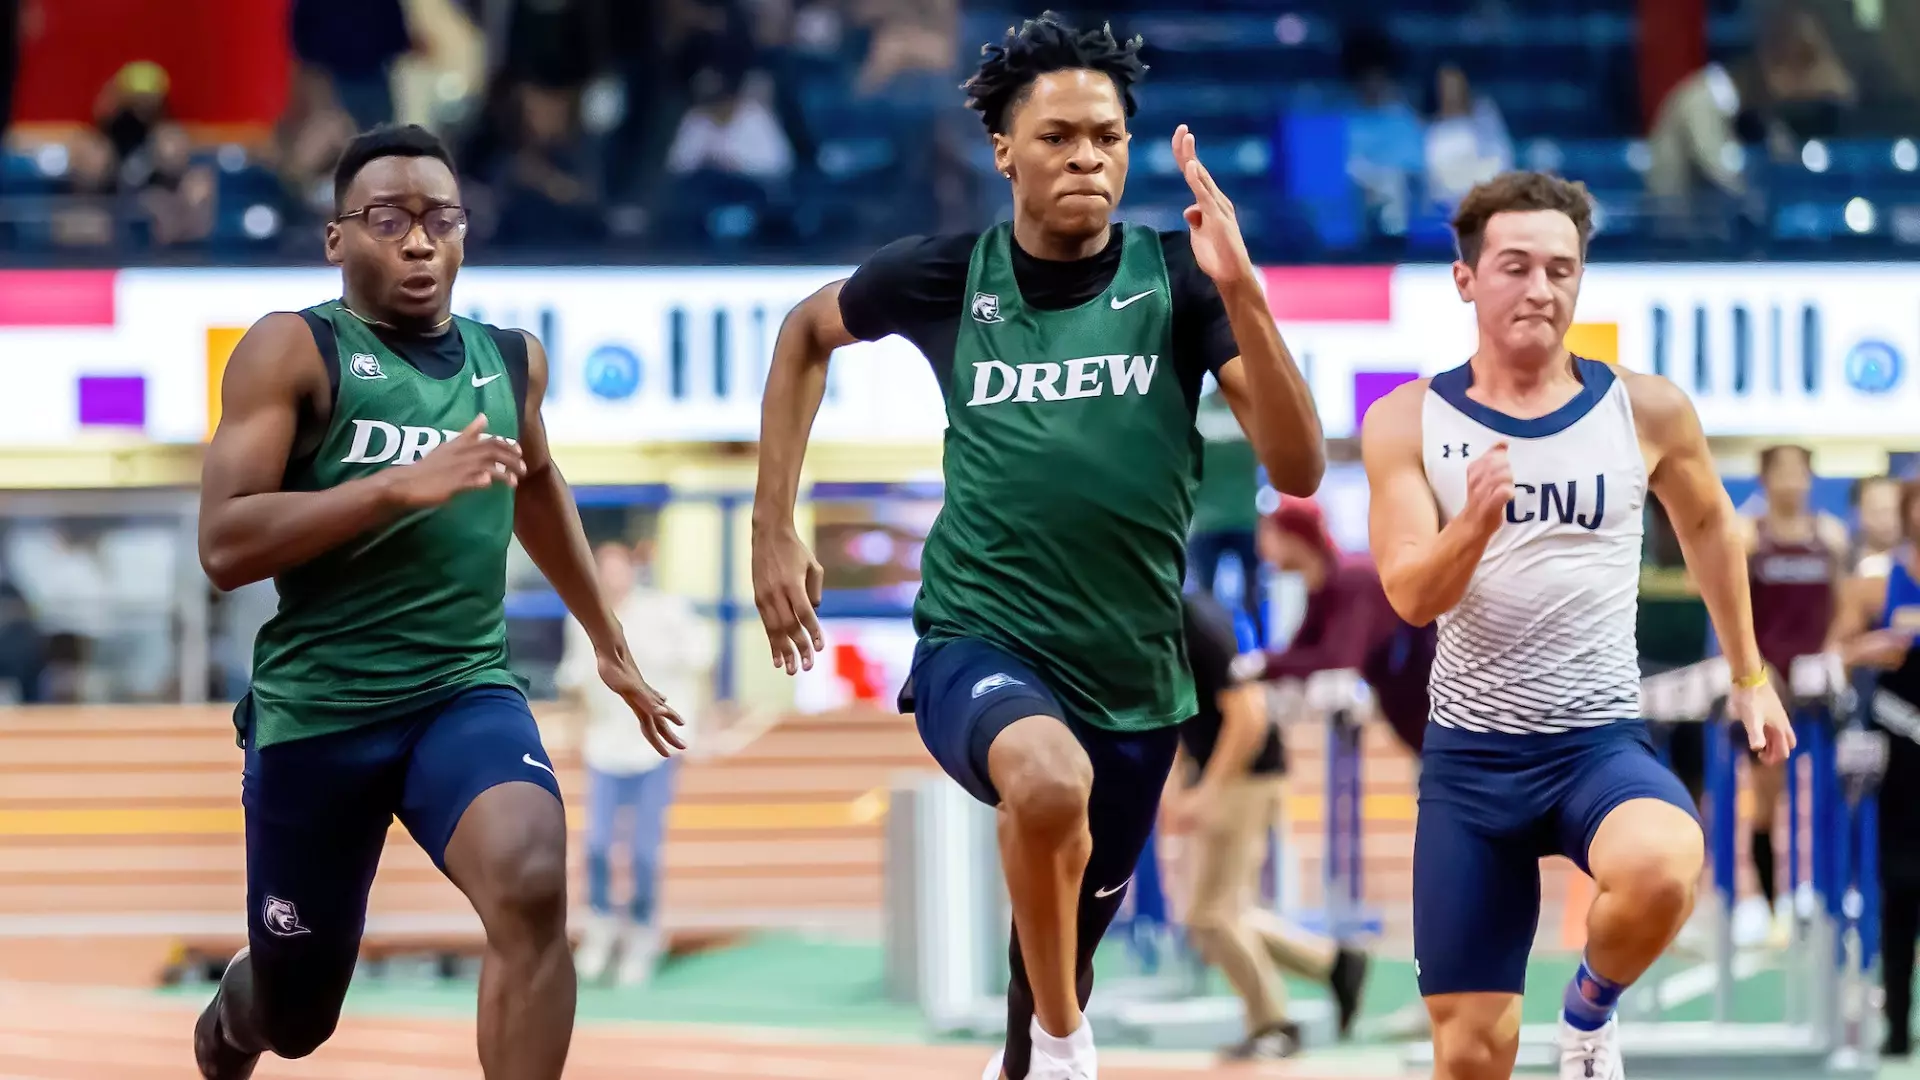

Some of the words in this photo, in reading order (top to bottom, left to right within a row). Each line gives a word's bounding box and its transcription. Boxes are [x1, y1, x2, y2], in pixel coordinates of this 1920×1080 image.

[966, 354, 1159, 406] DREW
[340, 419, 517, 473] DR
[1506, 473, 1605, 530] CNJ
